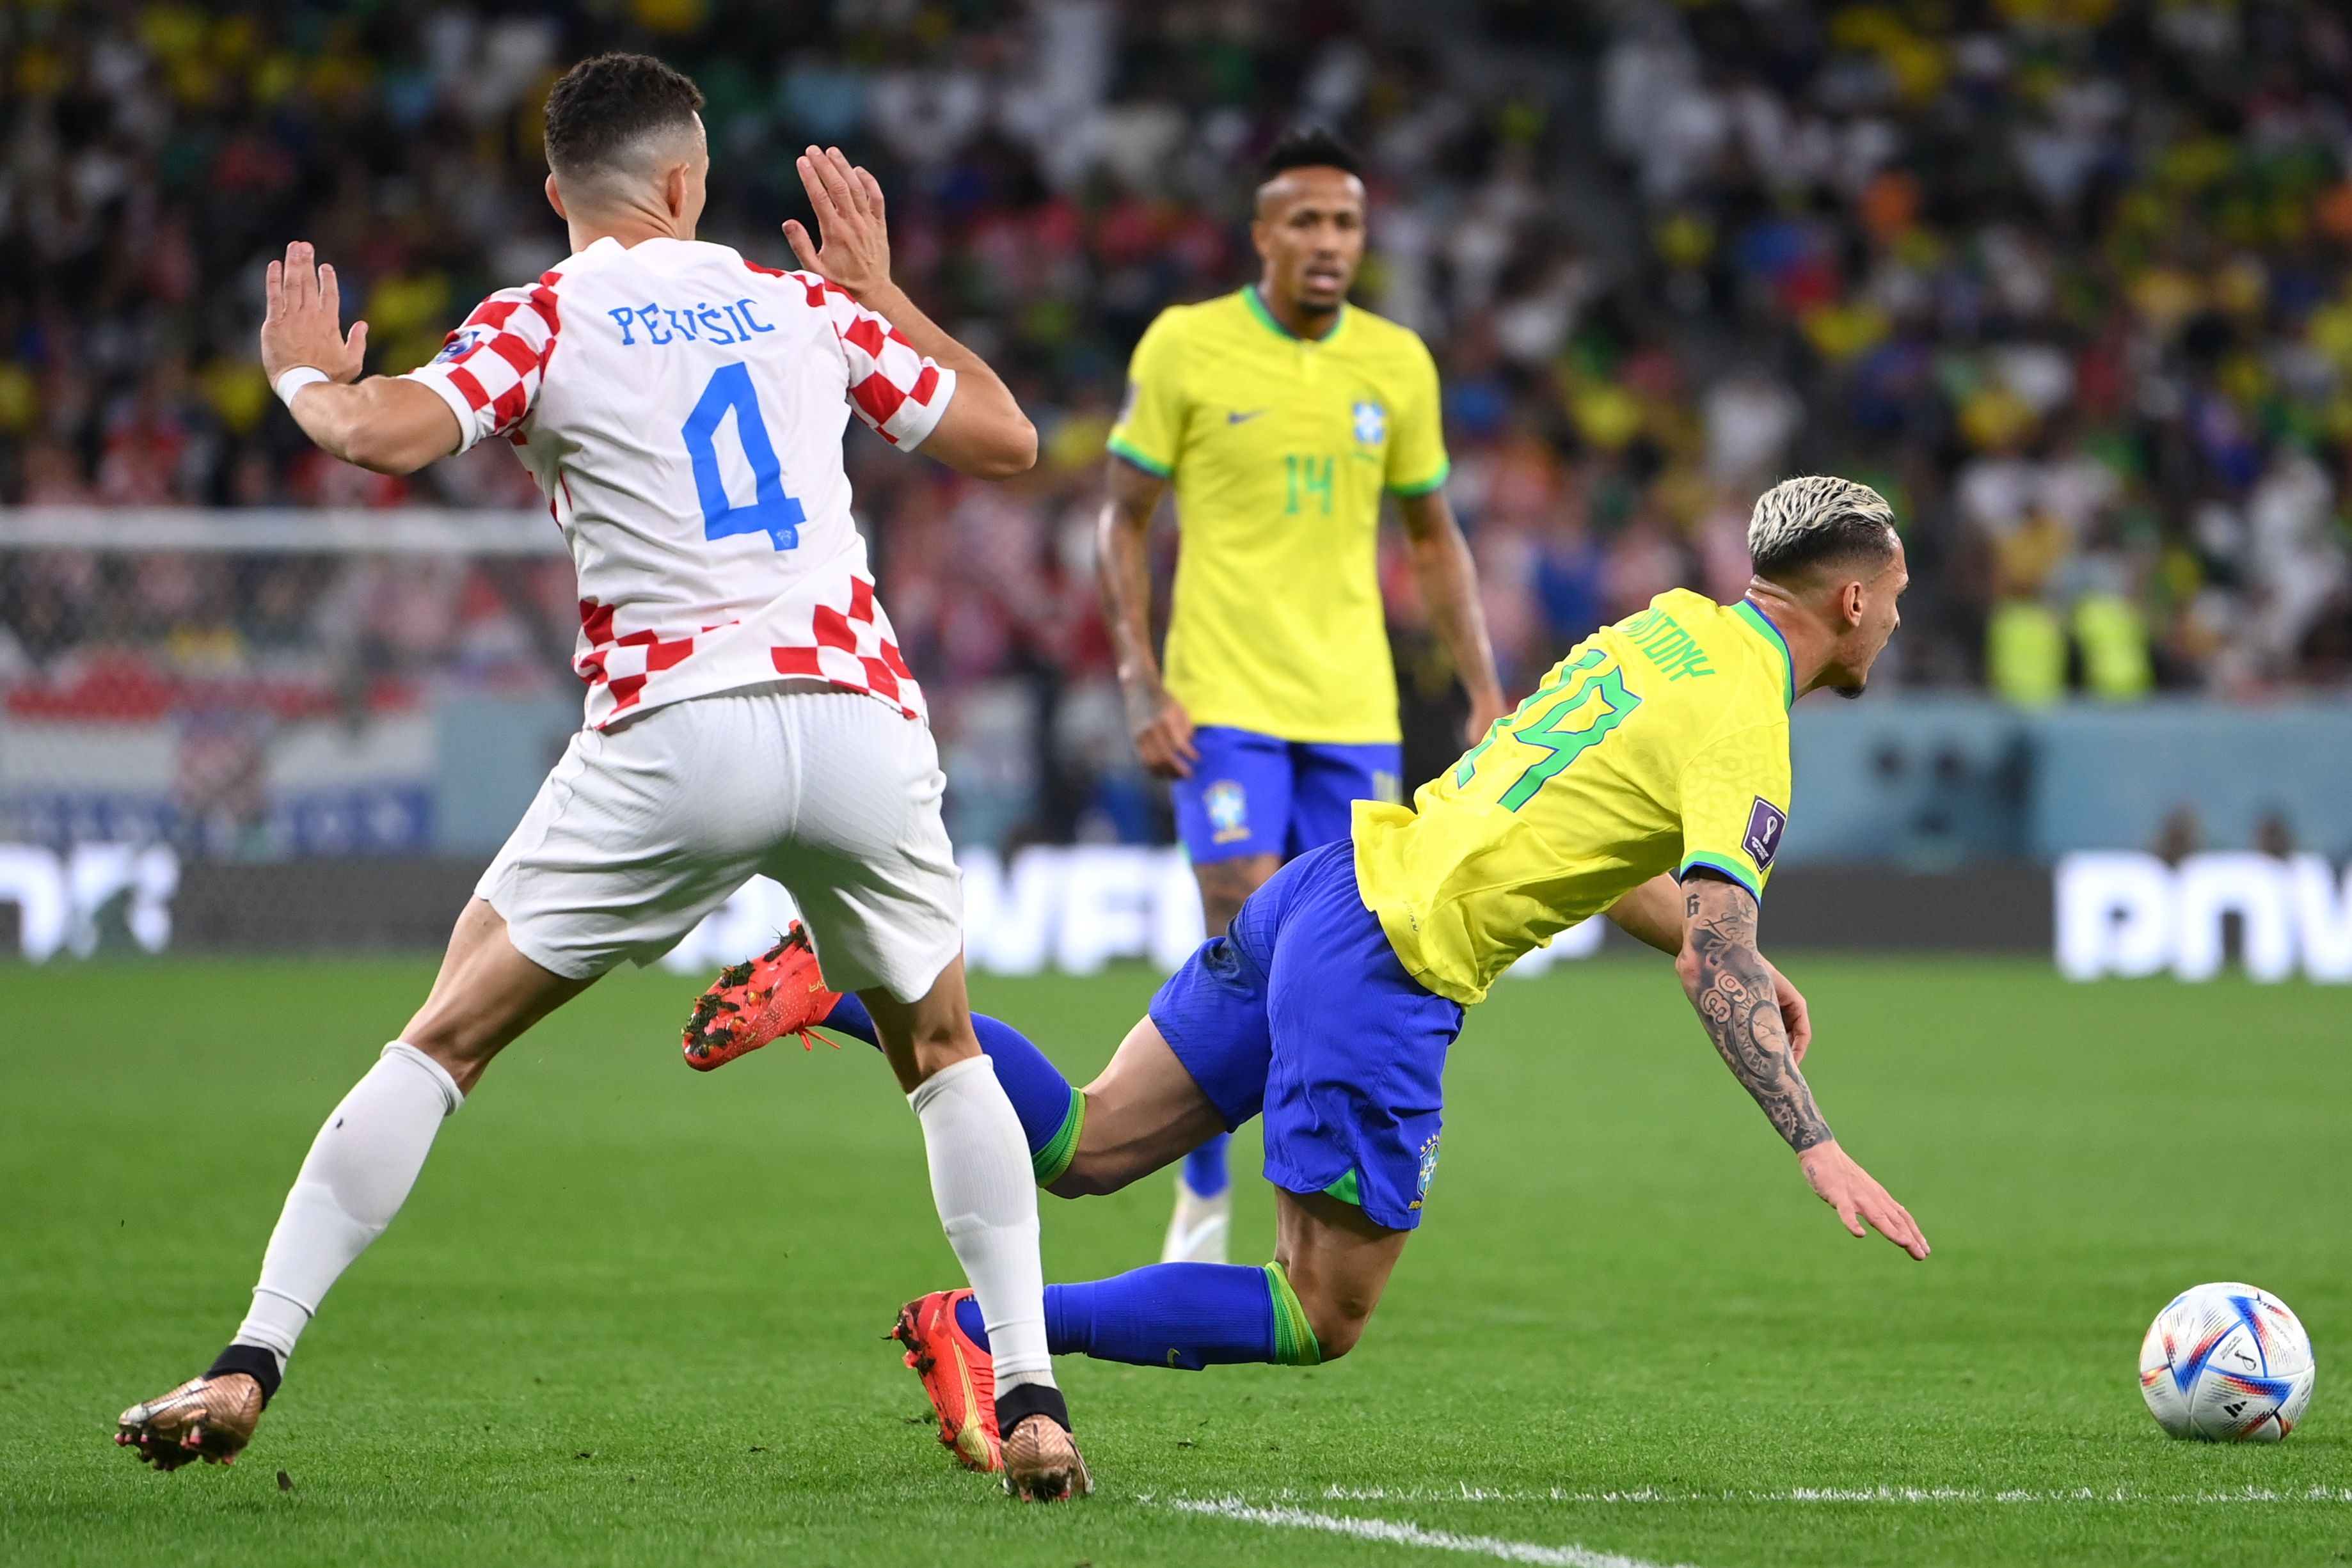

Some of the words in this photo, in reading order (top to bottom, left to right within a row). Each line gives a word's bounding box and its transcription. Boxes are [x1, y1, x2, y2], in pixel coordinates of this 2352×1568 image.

[681, 361, 807, 552] 4
[1286, 454, 1334, 514] 14
[1623, 607, 1716, 682] ANTONY
[1454, 649, 1642, 812] 19
